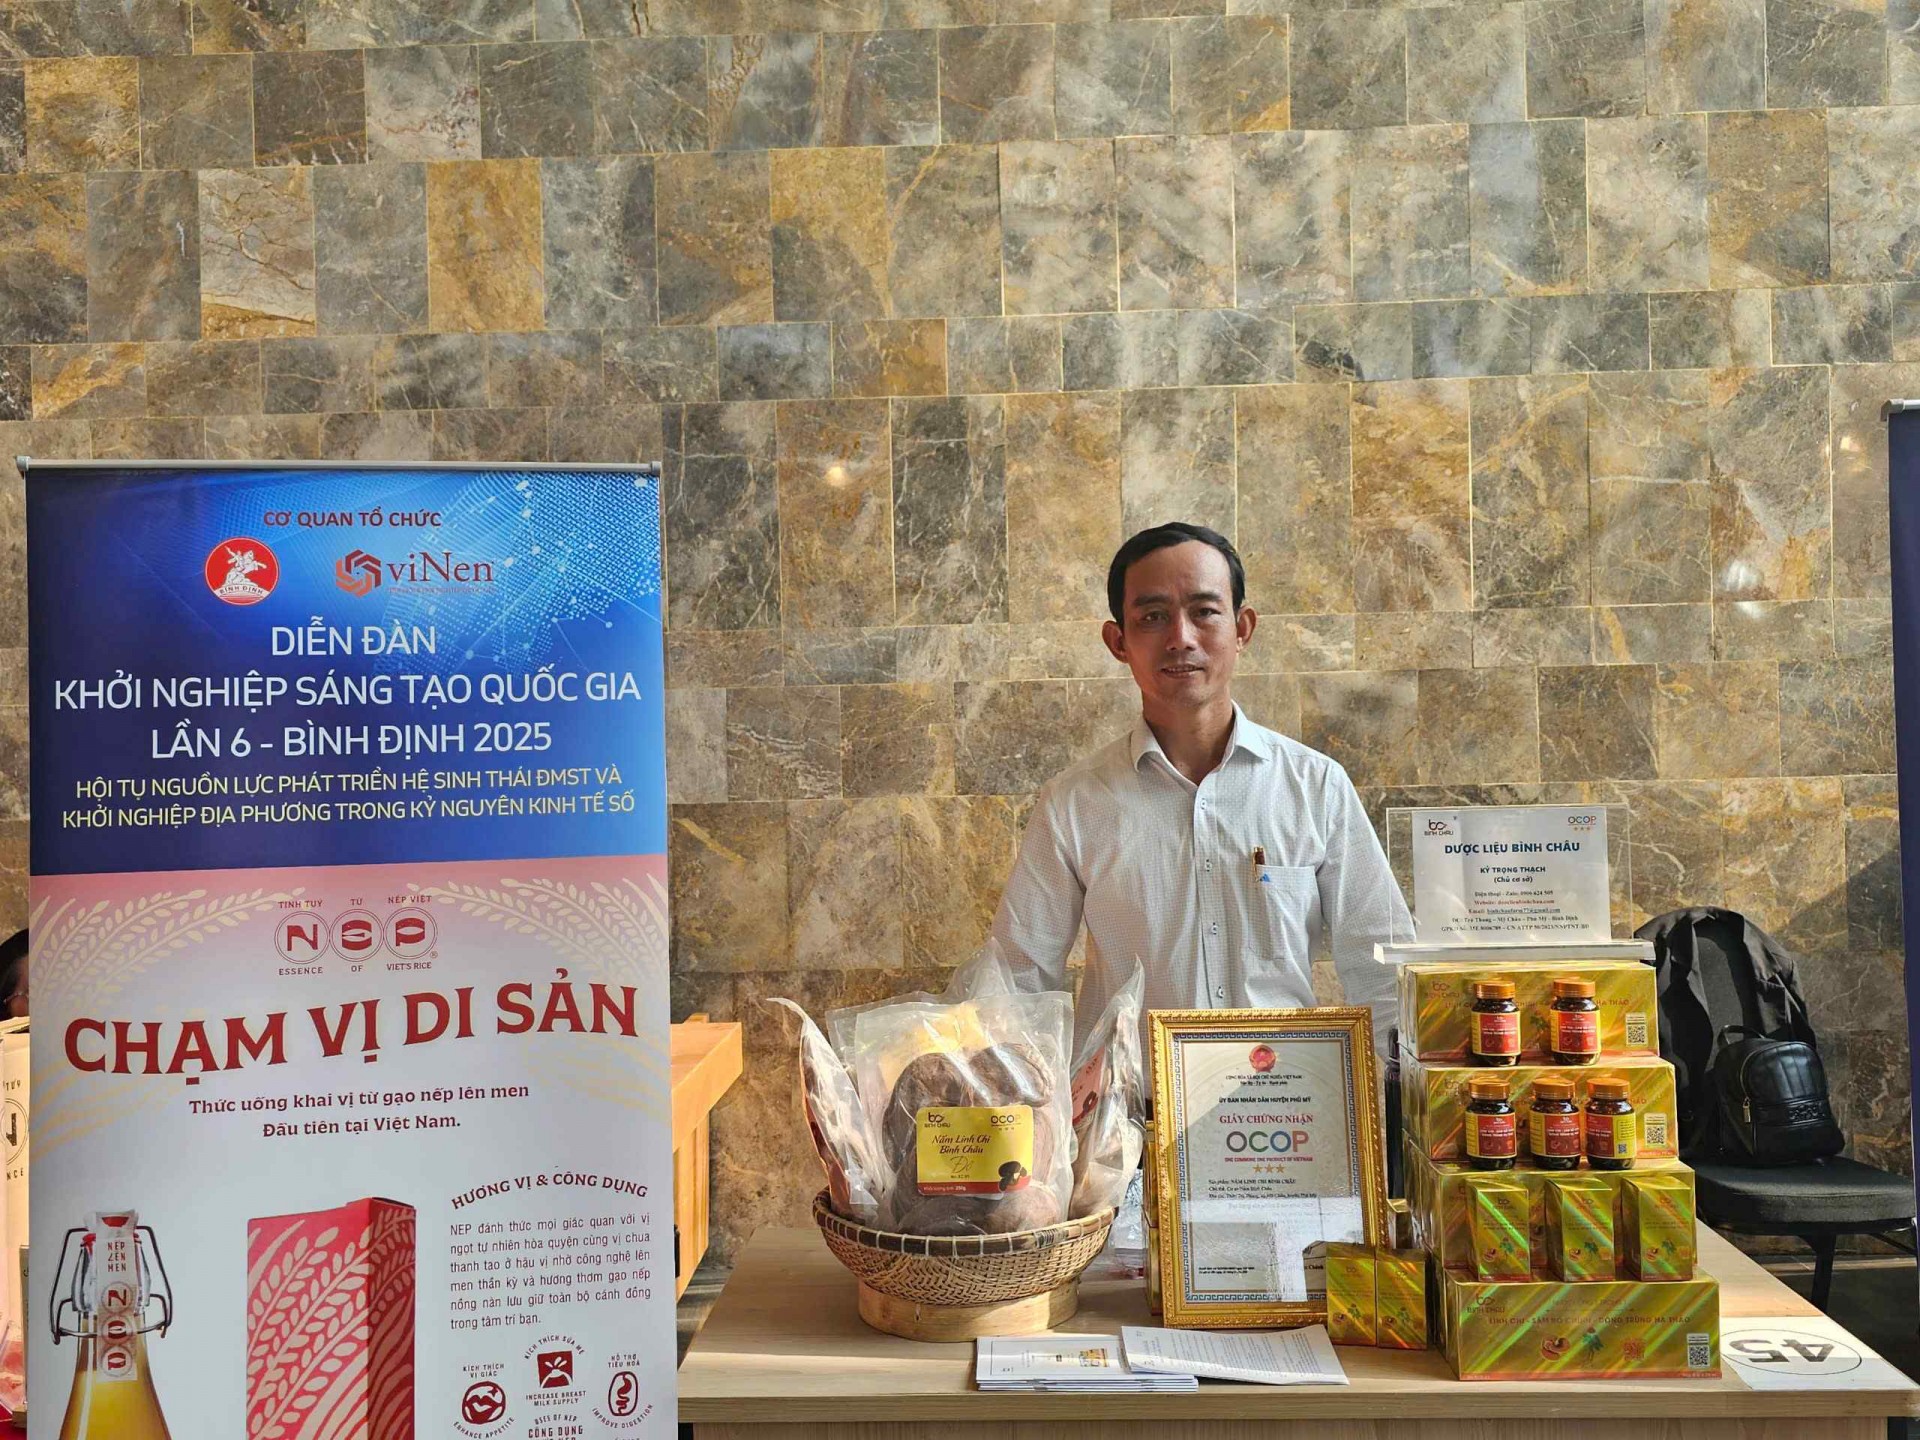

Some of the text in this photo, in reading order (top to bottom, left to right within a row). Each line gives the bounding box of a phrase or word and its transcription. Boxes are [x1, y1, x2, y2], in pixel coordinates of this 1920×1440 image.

[263, 506, 442, 528] CƠ QUAN TỔ CHỨC
[387, 552, 494, 583] viNen
[271, 616, 437, 656] DIỄN ĐÀN
[55, 663, 642, 713] KHỞI NGHIỆP SÁNG TẠO QUỐC GIA
[152, 718, 221, 759] LẦN
[230, 727, 251, 758] 6
[284, 719, 369, 757] BÌNH
[377, 722, 464, 760] ĐỊNH
[473, 721, 552, 752] 2025
[76, 763, 622, 801] HỘI TỤ NGUỒN LỰC PHÁT TRIỂN HỆ SINH THÁI ĐMST VÀ
[62, 789, 635, 829] KHỞI NGHIỆP ĐỊA PHƯƠNG TRONG KỶ NGUYÊN KINH TẾ SỐ
[1567, 815, 1597, 824] OCOP
[1444, 839, 1580, 856] DƯỢC LIỆU BÌNH CHÂU
[278, 967, 323, 976] ESSENCE
[351, 965, 363, 973] OF
[414, 962, 433, 970] RICE
[64, 967, 639, 1085] CHẠM VỊ DI SẢN
[189, 1086, 530, 1115] Thức uống khai vị từ gạo nếp lên men
[263, 1114, 462, 1138] Đầu tiên tại Việt Nam.
[1219, 1113, 1313, 1125] GIẤY CHỨNG NHẬN
[1226, 1130, 1310, 1153] OCOP
[451, 1171, 649, 1210] HƯƠNG VỊ & CÔNG DỤNG
[450, 1212, 650, 1235] NEP đánh thức mọi giác quan với vị
[450, 1232, 650, 1256] ngọt tự nhiên hòa quyện cùng vị chua
[450, 1261, 480, 1273] thanh
[484, 1259, 500, 1271] tao
[516, 1257, 535, 1270] hậu
[540, 1256, 549, 1269] vị
[552, 1254, 572, 1266] nhờ
[576, 1253, 602, 1266] công
[606, 1250, 631, 1264] nghệ
[635, 1250, 650, 1261] lên
[450, 1281, 473, 1292] men
[523, 1275, 535, 1287] và
[540, 1274, 572, 1287] hương
[577, 1272, 603, 1283] thơm
[608, 1271, 627, 1284] gạo
[632, 1267, 651, 1281] nếp
[482, 1296, 502, 1308] nàn
[507, 1295, 522, 1307] lưu
[549, 1292, 571, 1304] toàn
[576, 1290, 590, 1303] bộ
[595, 1288, 620, 1301] cánh
[450, 1313, 541, 1330] trong tâm trí bạn.
[1729, 1338, 1835, 1363] 45
[525, 1390, 587, 1400] INCREASE BREAST
[533, 1398, 580, 1407] MILK SUPPLY
